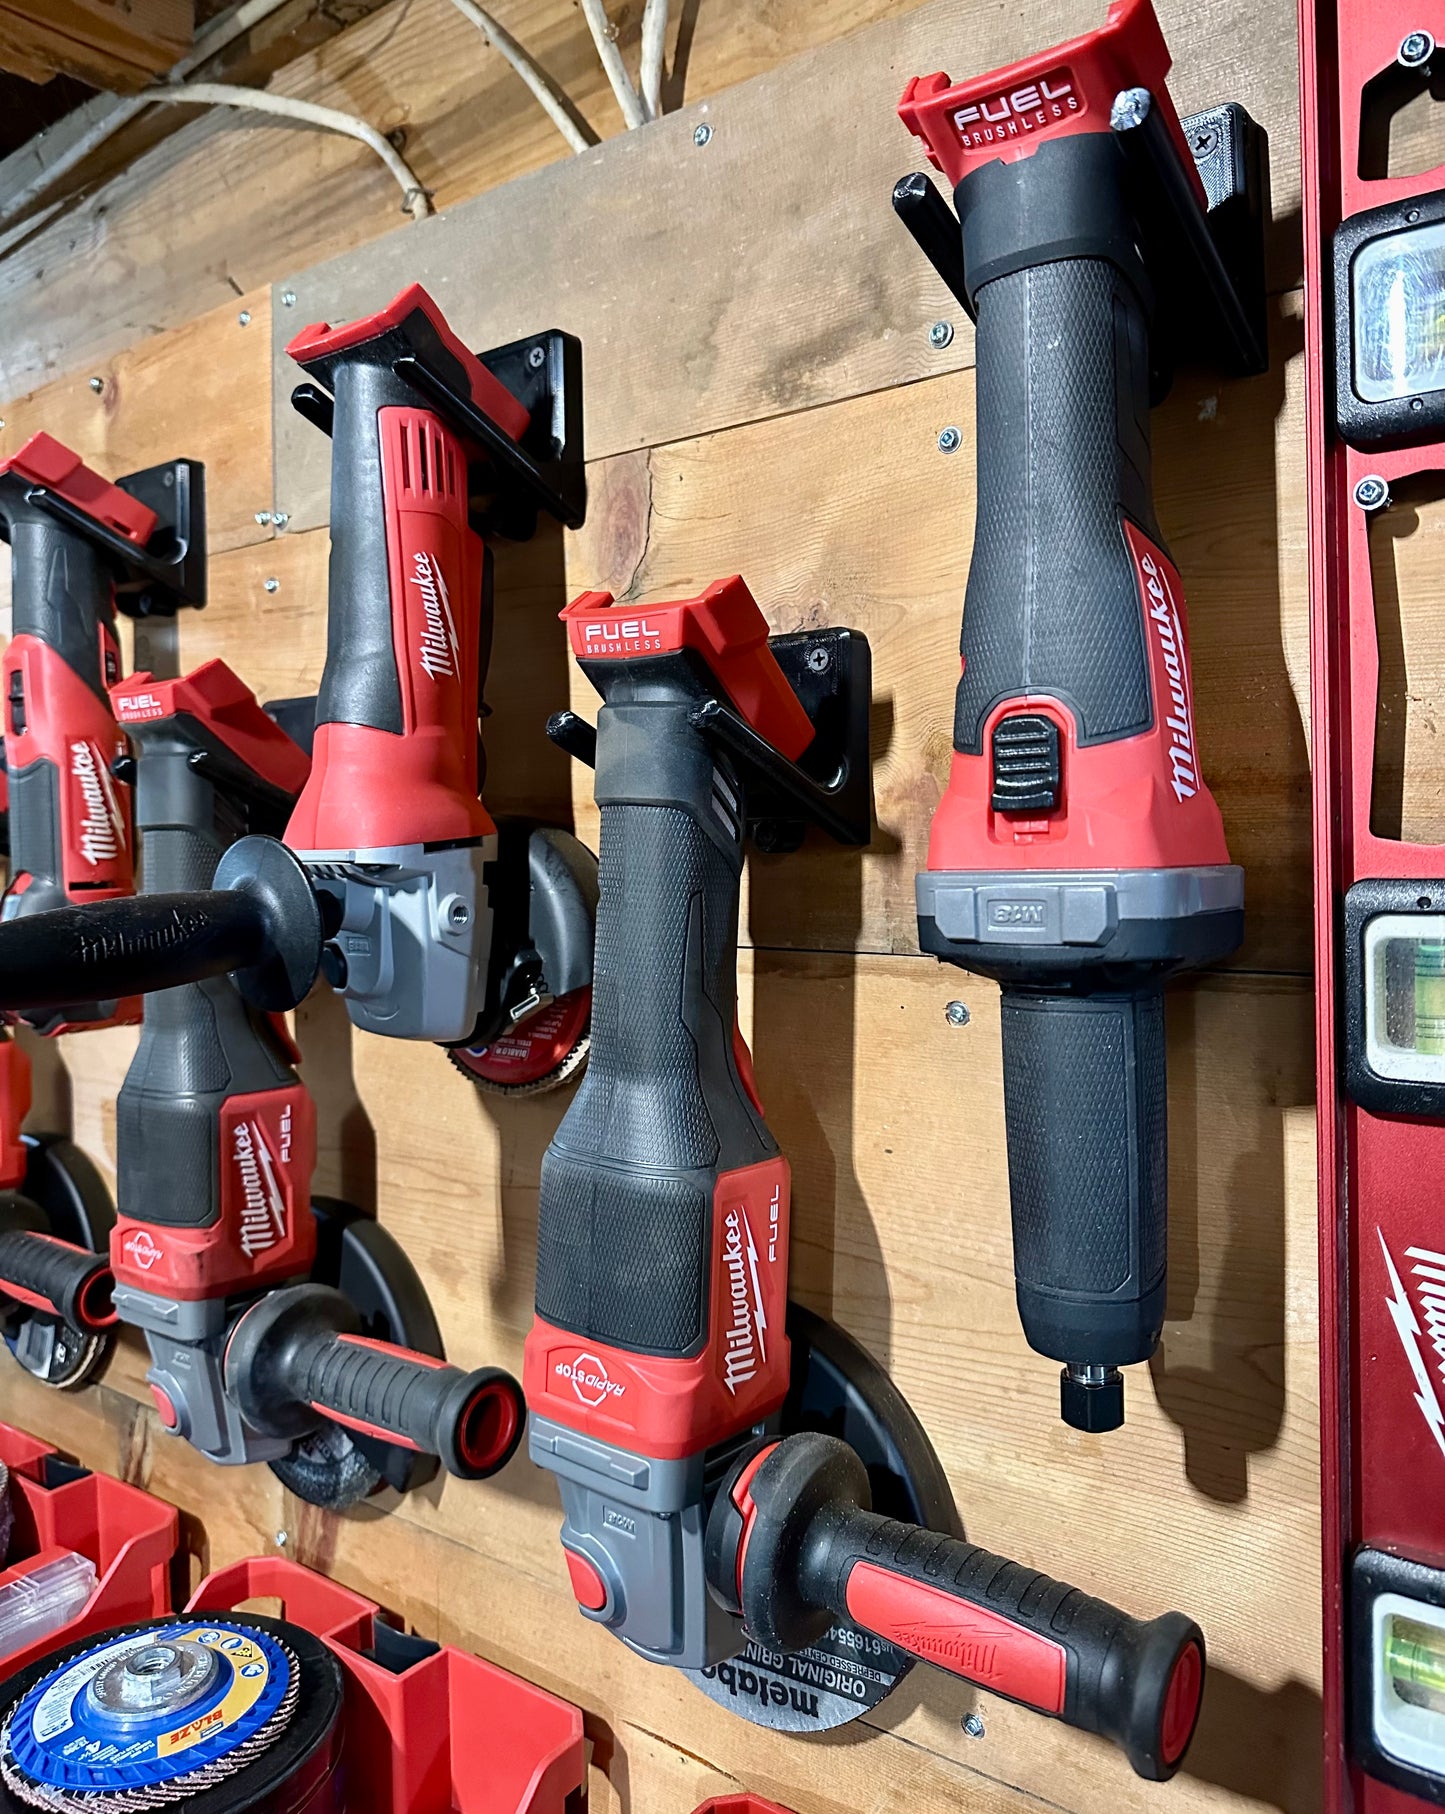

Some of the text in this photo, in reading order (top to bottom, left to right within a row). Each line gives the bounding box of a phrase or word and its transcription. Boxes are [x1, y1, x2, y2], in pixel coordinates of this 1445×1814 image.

[953, 81, 1072, 131] FUEL
[961, 97, 1078, 147] BRUSHLESS
[410, 551, 454, 681] Milwaukee
[585, 620, 660, 641] FUEL
[587, 639, 661, 654] BRUSHLESS
[118, 694, 161, 711] FUEL
[1141, 552, 1197, 803] Milwaukee
[70, 740, 118, 866] Milwaukee
[994, 904, 1043, 924] M18
[279, 1104, 292, 1163] FUEL
[232, 1121, 276, 1259] Milwaukee
[768, 1184, 780, 1263] FUEL
[722, 1209, 757, 1396] Milwaukee
[555, 1362, 626, 1397] RAPIDSTOP
[741, 1641, 867, 1699] ORIGINAL GRIN
[829, 1656, 882, 1682] DEPRESSED
[892, 1627, 1003, 1680] Milwaukee
[169, 1709, 223, 1745] BLAZE
